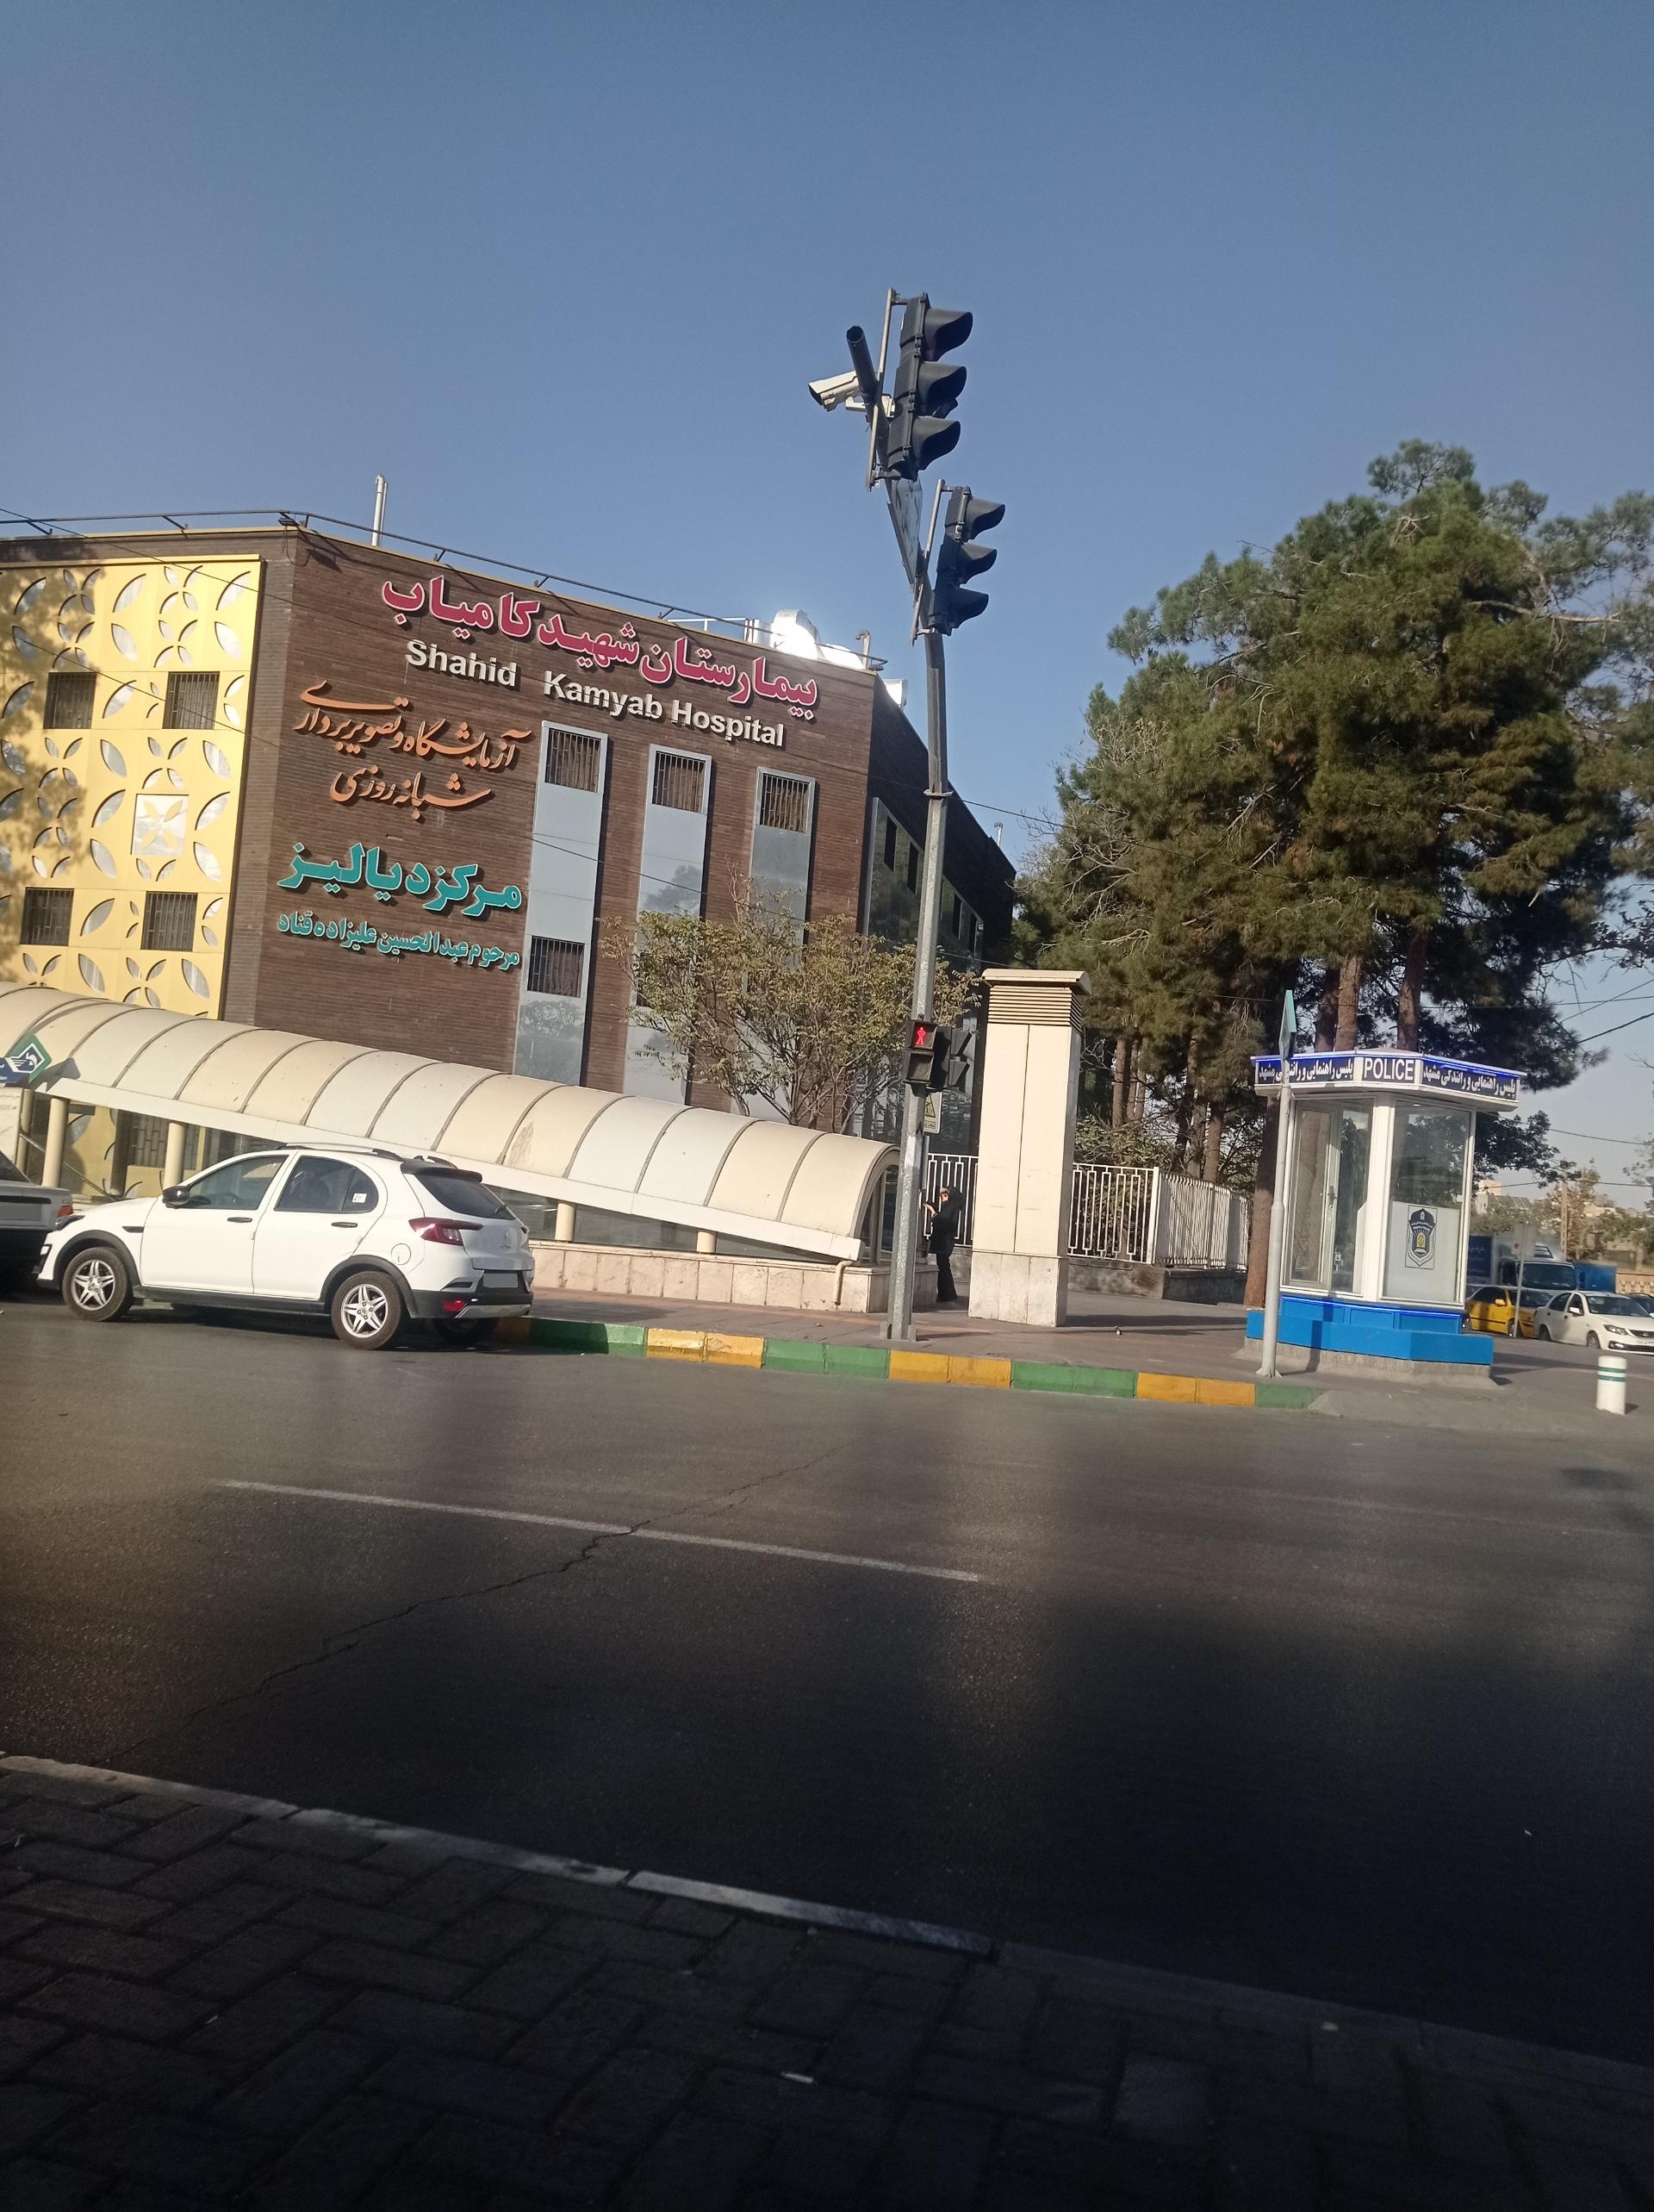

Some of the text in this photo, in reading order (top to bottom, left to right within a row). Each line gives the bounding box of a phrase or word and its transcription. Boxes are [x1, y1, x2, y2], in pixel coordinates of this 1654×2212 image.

[382, 575, 818, 720] بیمارستان شهید کامیاب
[405, 639, 784, 746] Shahid Kamyab Hospital
[389, 732, 405, 749] و
[402, 717, 532, 769] آزمایشگاه
[277, 842, 522, 917] مرکز دیالیز
[468, 944, 519, 970] مرحوم
[1259, 1062, 1275, 1081] مشهد
[1335, 1057, 1353, 1081] پلیس
[1364, 1057, 1415, 1081] POLICE
[1423, 1064, 1440, 1082] مشهد
[1499, 1078, 1516, 1098] پلیس
